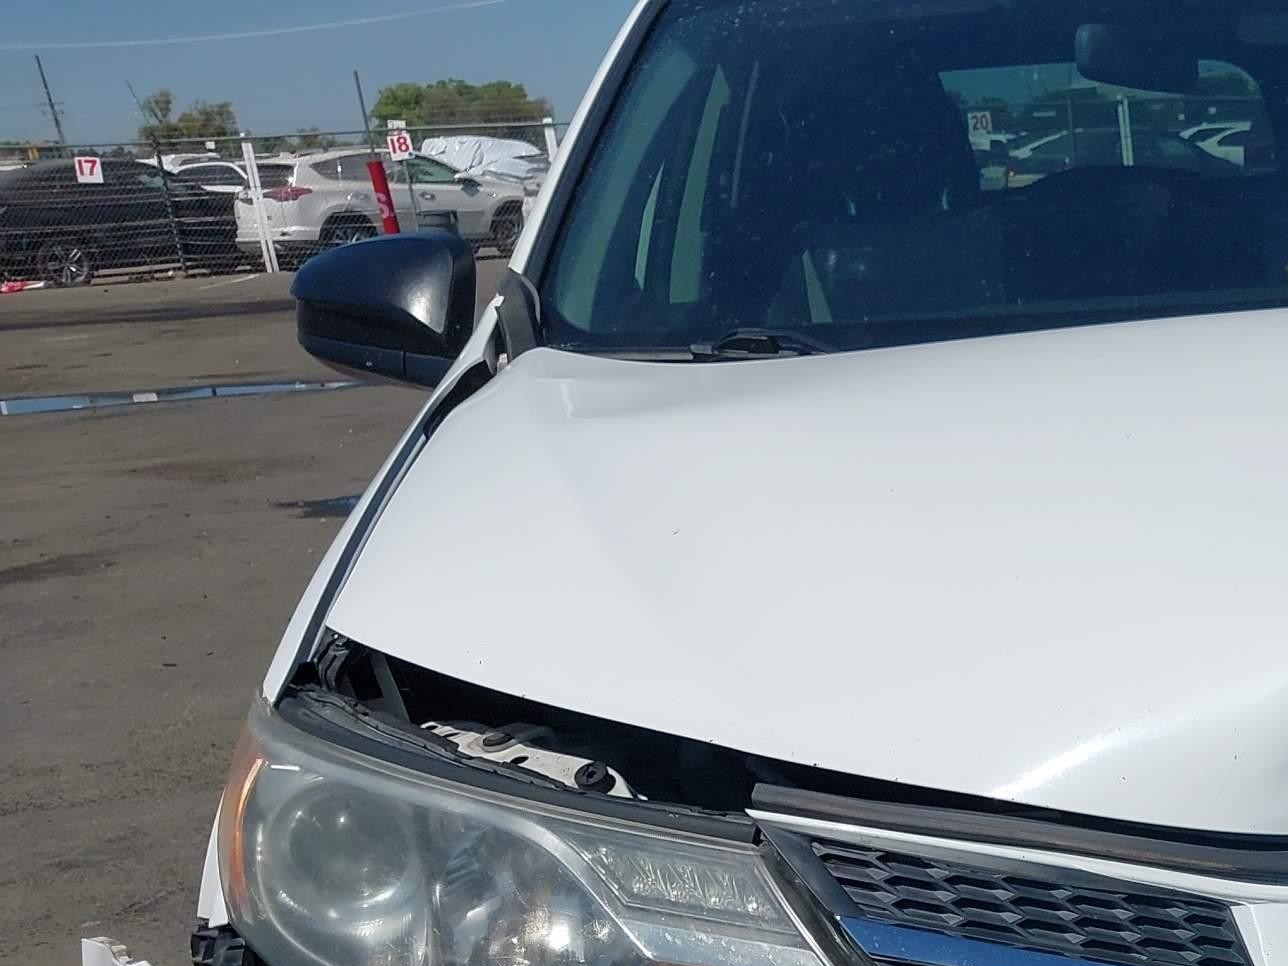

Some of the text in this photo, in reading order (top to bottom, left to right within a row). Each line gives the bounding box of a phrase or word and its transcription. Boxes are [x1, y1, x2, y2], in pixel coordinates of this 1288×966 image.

[970, 114, 989, 131] 20
[389, 135, 410, 154] 18
[76, 159, 98, 176] 17
